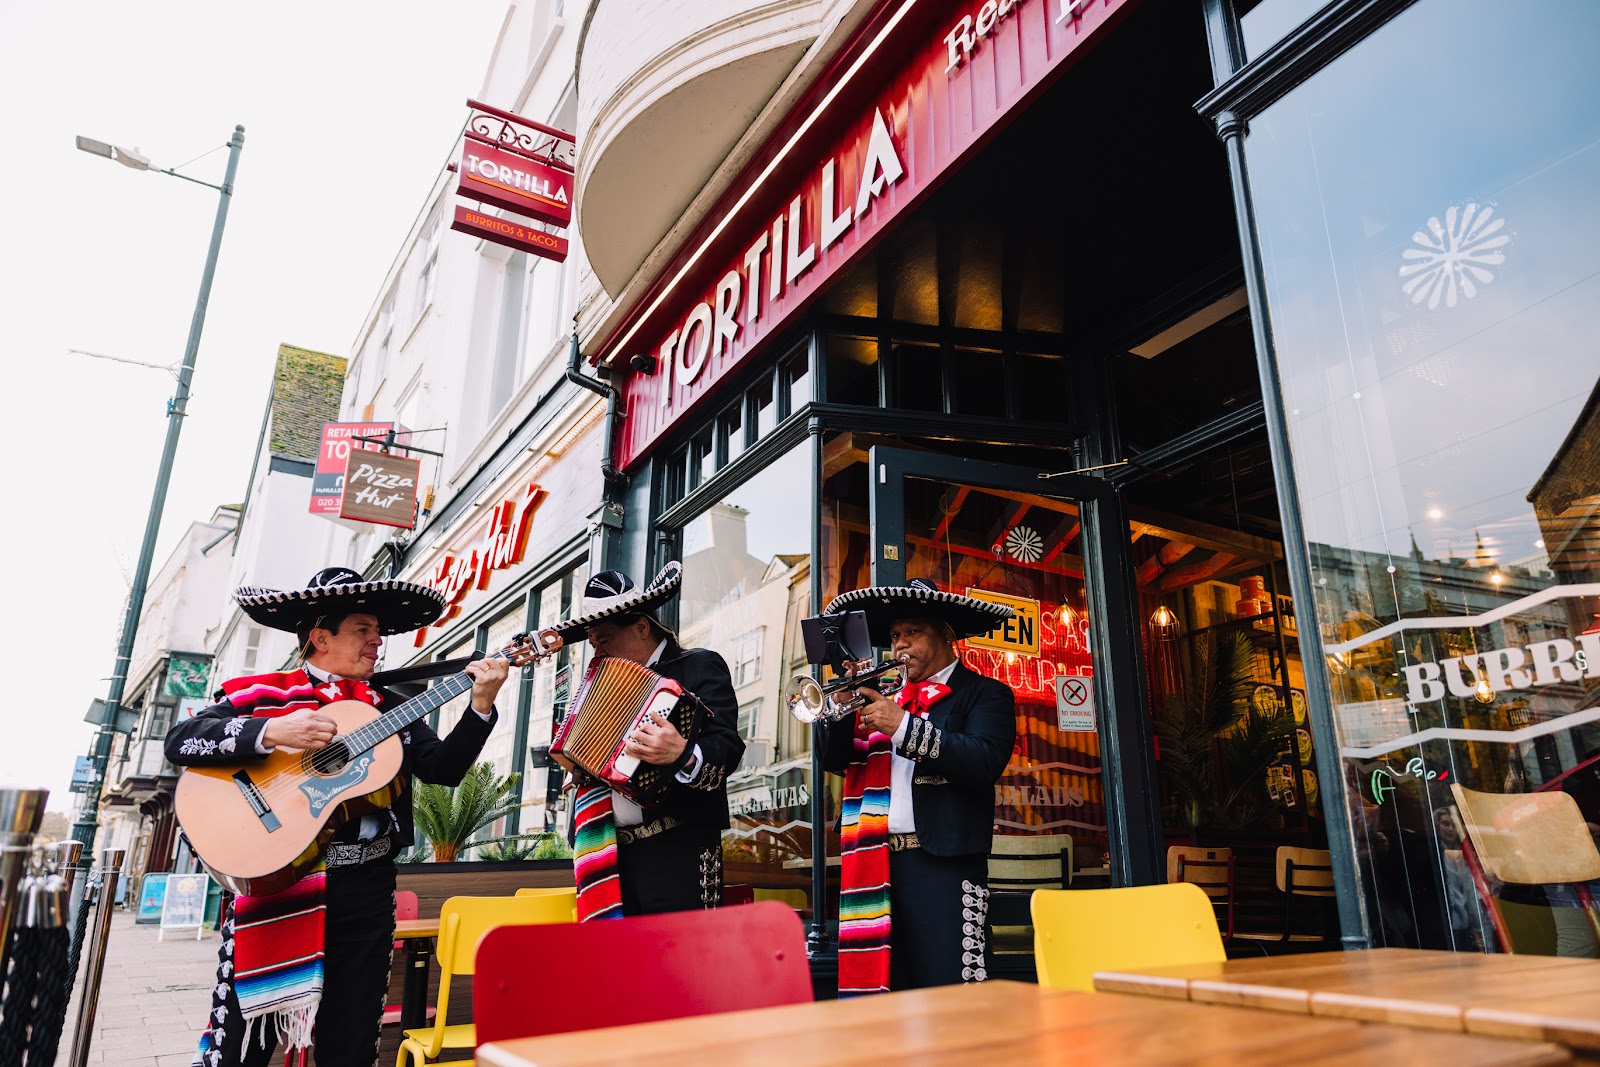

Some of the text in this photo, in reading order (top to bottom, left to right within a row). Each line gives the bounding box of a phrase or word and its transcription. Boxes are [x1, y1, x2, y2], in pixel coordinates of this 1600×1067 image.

[467, 154, 569, 205] TORTILLA
[465, 212, 558, 249] BURRITOS & TACOS
[660, 106, 904, 409] TORTILLA
[327, 427, 387, 439] RETAIL UNIT
[325, 440, 351, 460] TO
[349, 463, 414, 489] Pizza
[317, 498, 334, 507] 020
[355, 486, 405, 509] Hut
